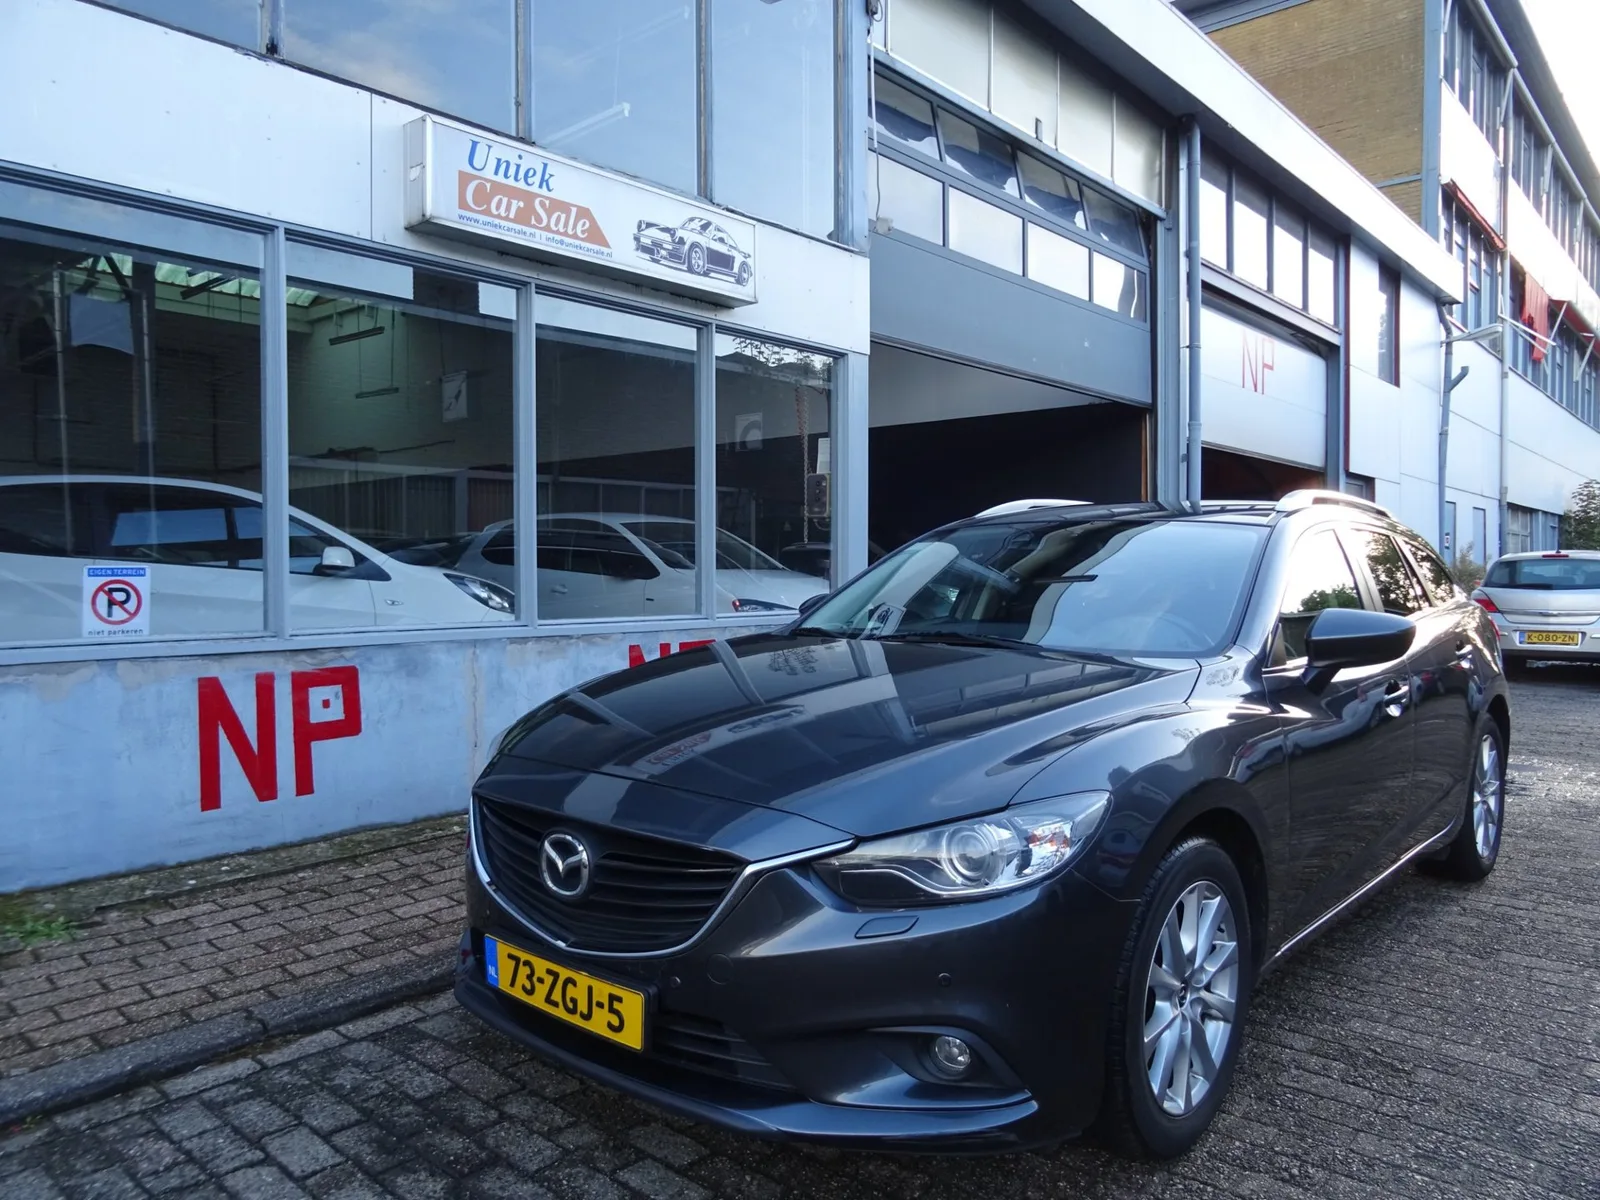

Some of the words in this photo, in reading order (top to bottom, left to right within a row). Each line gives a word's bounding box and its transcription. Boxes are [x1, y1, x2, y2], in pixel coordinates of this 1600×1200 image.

[467, 139, 555, 193] Uniek
[466, 179, 524, 219] Car
[531, 197, 590, 238] Sale
[457, 213, 536, 239] www.uniekcarsale.nl
[545, 235, 613, 258] info@uniekcarsale.nl
[1241, 329, 1275, 395] NP
[88, 568, 112, 576] EIGEN
[113, 568, 145, 576] TERREIN
[107, 628, 144, 637] parkeren
[1527, 632, 1575, 643] K-080-ZN
[197, 665, 362, 812] NP
[488, 964, 498, 979] NL
[506, 952, 625, 1034] 73-ZGJ-5
